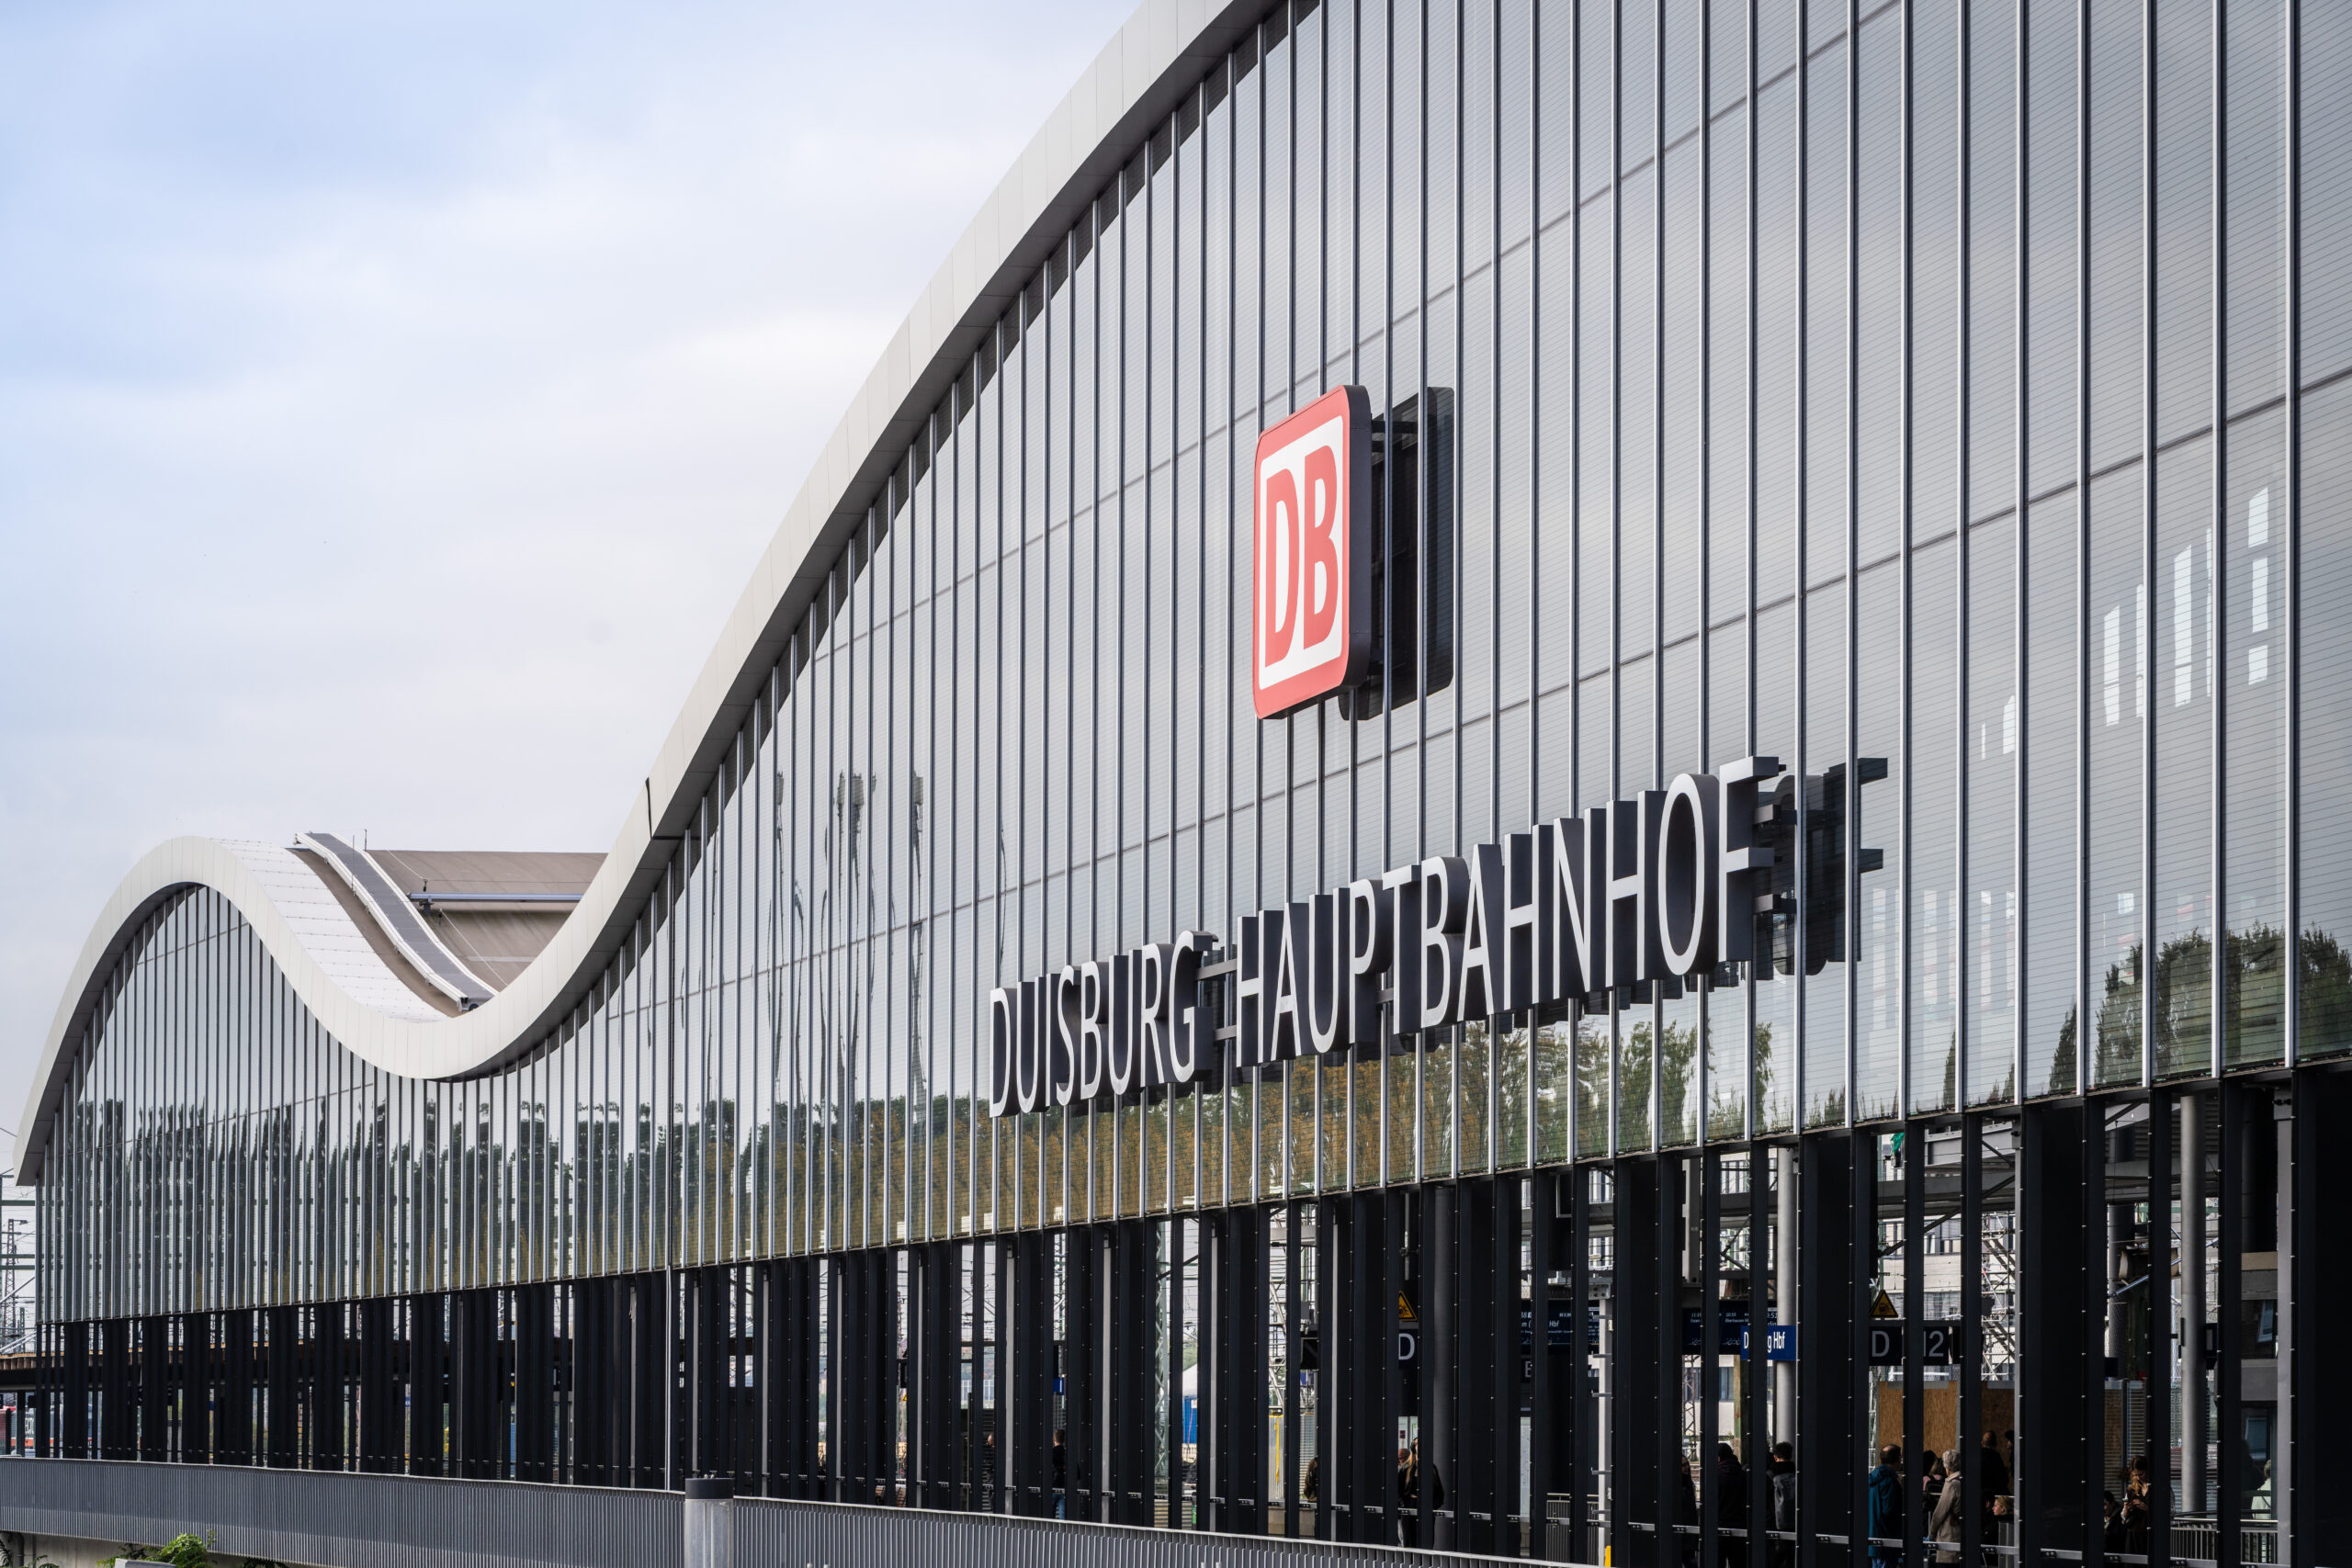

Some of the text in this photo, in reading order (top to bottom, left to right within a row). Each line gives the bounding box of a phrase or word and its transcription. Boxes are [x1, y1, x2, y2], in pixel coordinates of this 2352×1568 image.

[1265, 445, 1339, 668] DB
[989, 756, 1780, 1118] DUISBURG HAUPTBAHNHOF
[1397, 1333, 1416, 1360] D
[1773, 1331, 1786, 1349] Hbf
[1871, 1330, 1890, 1358] D
